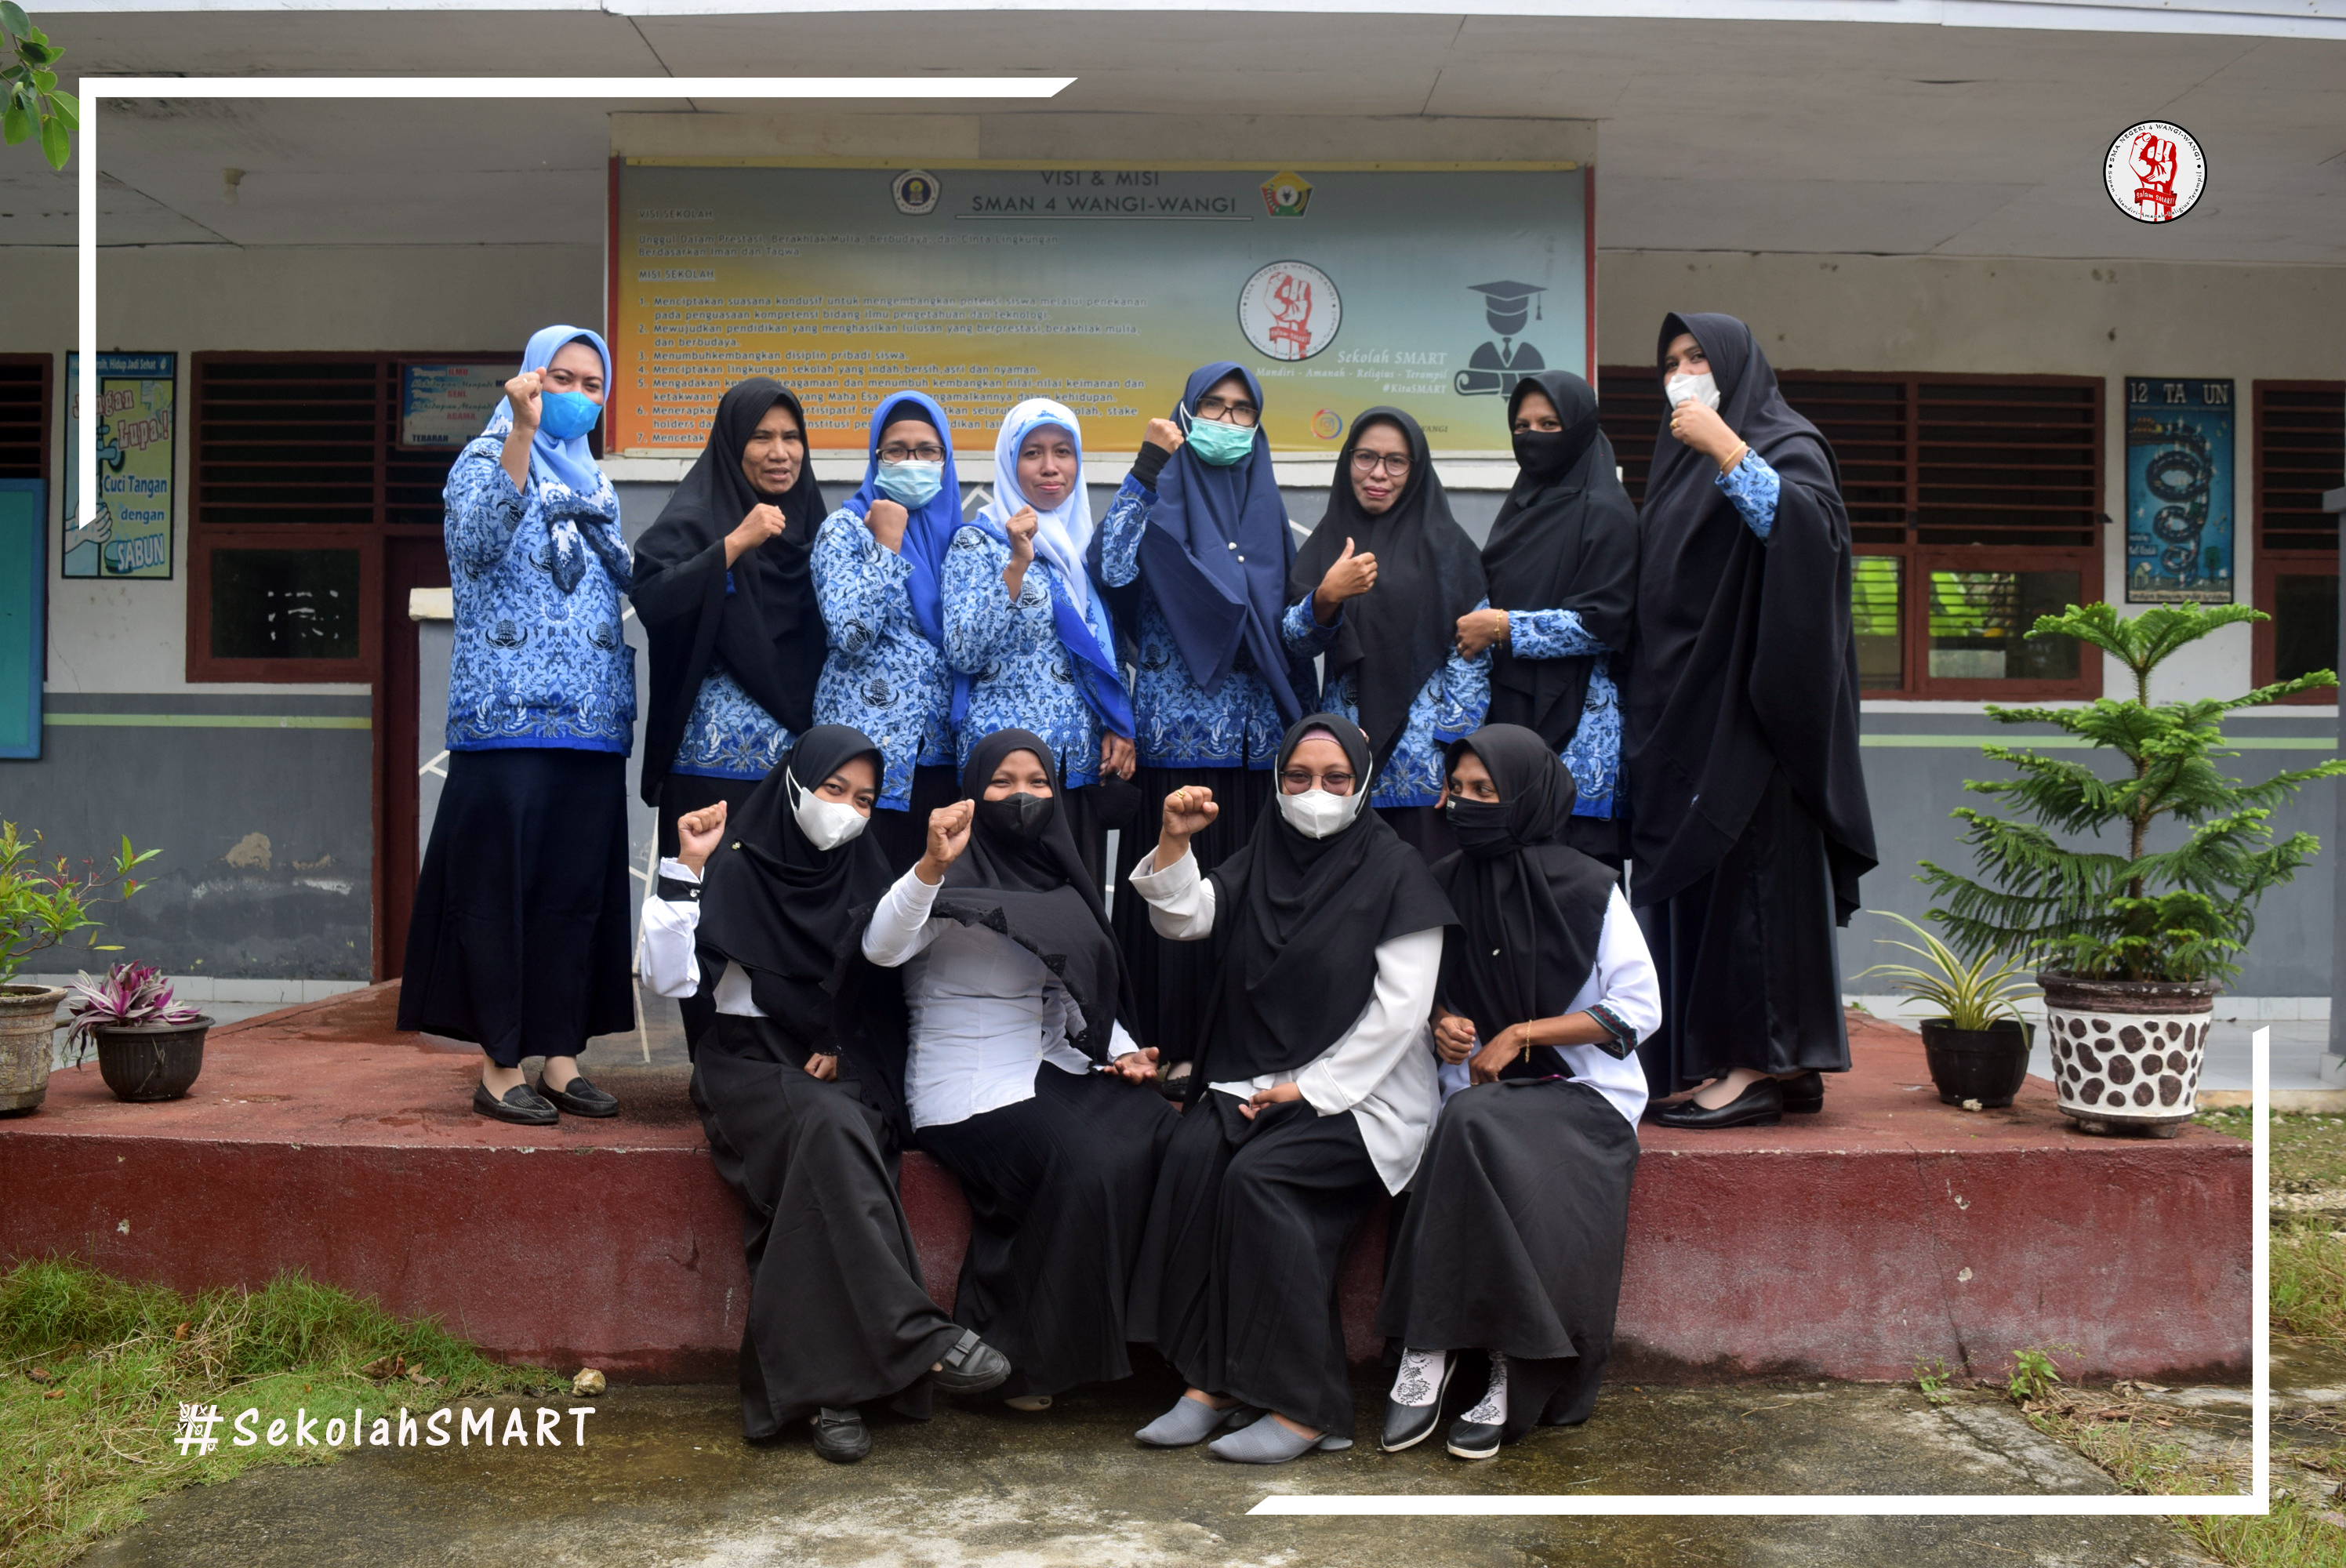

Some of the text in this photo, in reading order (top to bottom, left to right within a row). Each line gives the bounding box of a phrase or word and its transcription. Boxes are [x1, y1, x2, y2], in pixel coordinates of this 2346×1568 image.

[1041, 171, 1159, 187] VISI & MISI
[972, 196, 1236, 212] SMAN 4 WANGI-WANGI
[639, 210, 713, 219] VISI SEKOLAH
[639, 235, 676, 245] Unggul
[681, 235, 714, 244] Dalam
[719, 235, 766, 245] Prestasi,
[772, 235, 826, 244] Berakhlak
[870, 235, 932, 245] Berbudaya,
[996, 235, 1058, 245] Lingkungan
[639, 248, 800, 257] Berdasarkan Iman dan Taqwa
[639, 270, 714, 278] MISI SEKOLAH
[639, 297, 649, 306] 1.
[654, 297, 724, 307] Menciptakan
[775, 297, 823, 306] kondusif
[827, 297, 859, 306] untuk
[863, 297, 956, 307] mengembangkan
[961, 297, 1001, 307] potensi
[1006, 297, 1036, 306] siswa
[1040, 297, 1082, 306] melalui
[1087, 297, 1146, 307] penekanan
[655, 310, 1051, 321] pada penguasaan kompetensi bidang ilmu pengetahuan dan teknologi.
[638, 325, 649, 333] 2.
[654, 325, 722, 335] Mewujudkan
[726, 325, 787, 335] pendidikan
[792, 325, 818, 335] yang
[822, 324, 898, 334] menghasilkan
[902, 324, 942, 332] lulusan
[946, 325, 972, 335] yang
[1106, 324, 1141, 334] mulia,
[655, 338, 741, 348] dan berbudaya.
[638, 351, 910, 362] 3. Menumbuhkembangkan disiplin pribadi siswa.
[1338, 350, 1447, 365] Sekolah SMART
[637, 365, 648, 375] 4.
[652, 365, 723, 376] Menciptakan
[727, 365, 787, 376] lingkungan
[791, 365, 834, 374] sekolah
[838, 366, 864, 376] yang
[969, 365, 989, 374] dan
[993, 366, 1041, 376] nyaman.
[1255, 367, 1295, 377] Mandiri
[1306, 368, 1346, 378] Amanah
[1356, 368, 1394, 381] Religius
[1406, 369, 1447, 382] Terampil
[637, 379, 648, 388] 5.
[652, 379, 720, 390] Mengadakan
[844, 379, 863, 387] dan
[868, 379, 928, 387] menumbuh
[933, 379, 1002, 389] kembangkan
[1007, 379, 1062, 387] nilai-nilai
[1066, 379, 1120, 388] keimanan
[1124, 379, 1144, 388] dan
[1382, 383, 1447, 394] #KitaSMART
[654, 393, 713, 401] ketakwaan
[798, 394, 824, 403] yang
[828, 393, 856, 401] Maha
[861, 392, 878, 401] Esa
[1055, 393, 1117, 403] kehidupan.
[2130, 383, 2148, 404] 12
[637, 407, 647, 416] 6.
[1107, 406, 1138, 416] stake
[653, 420, 694, 429] holders
[637, 434, 705, 442] 7. Mencetak
[104, 475, 167, 498] Cuci Tangan
[121, 508, 165, 524] dengan
[118, 533, 165, 573] SABUN
